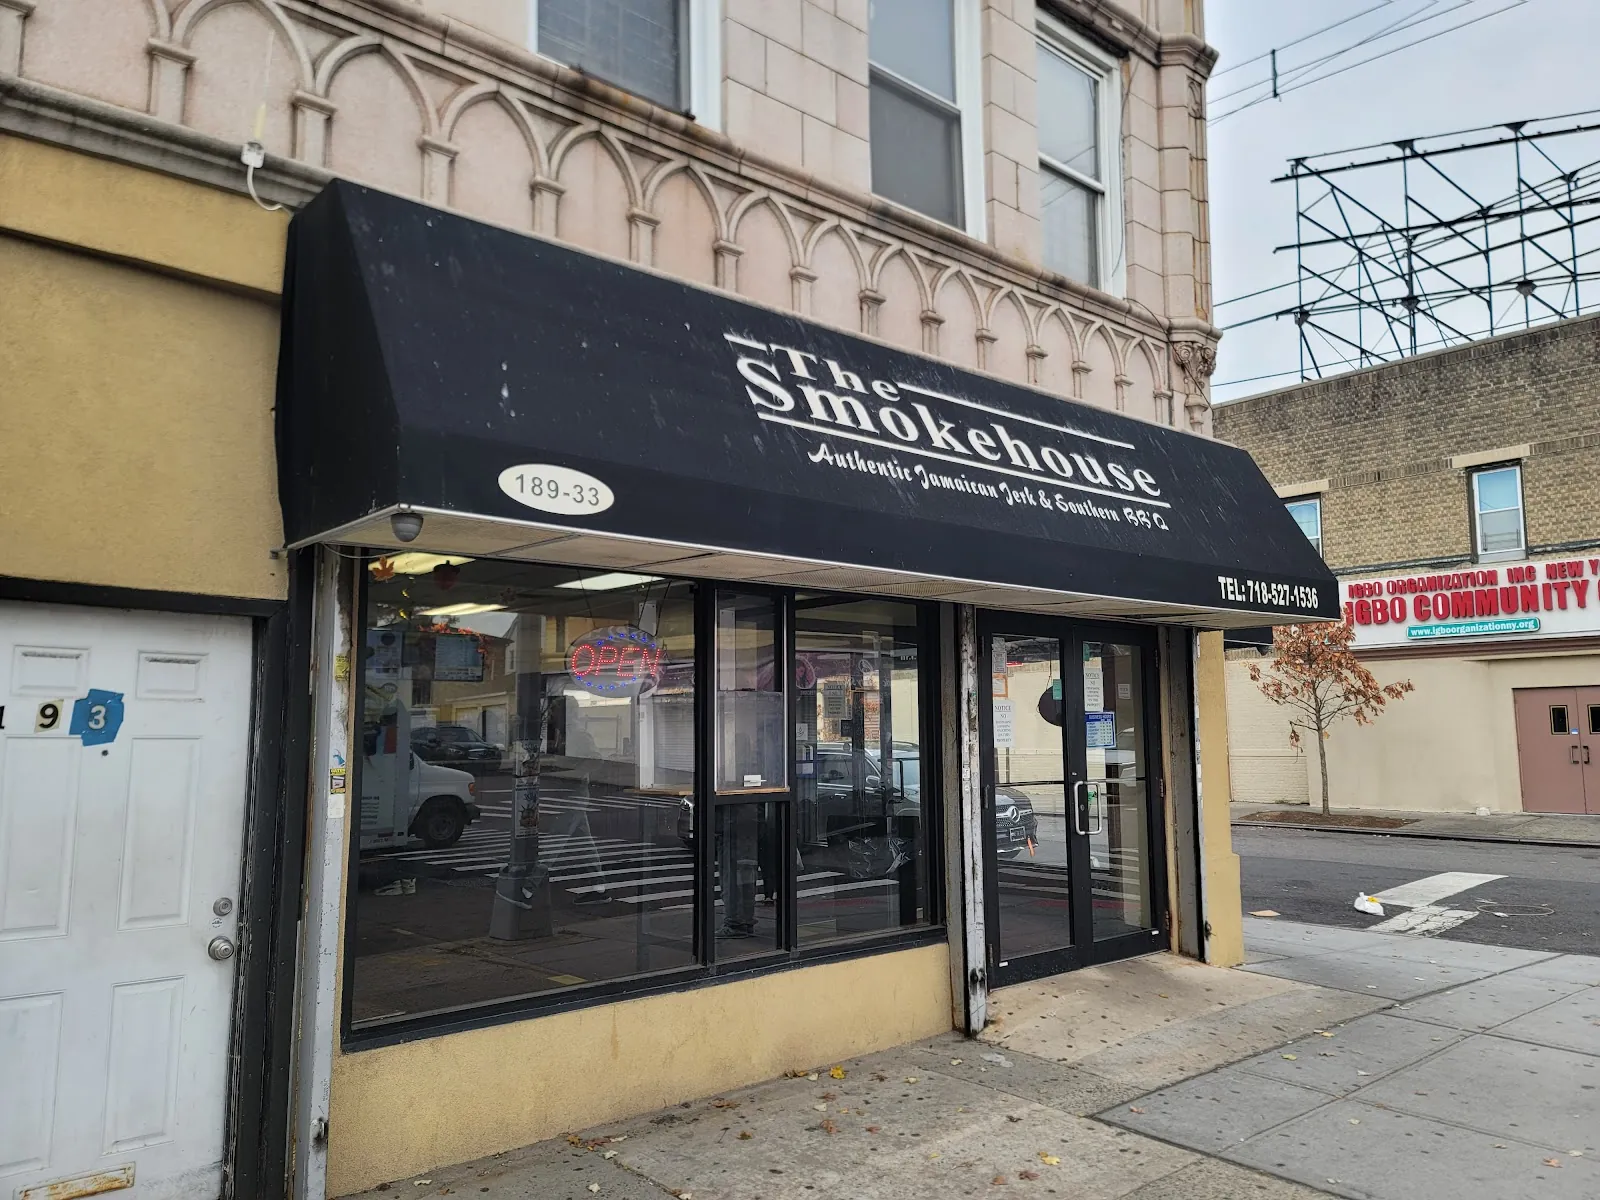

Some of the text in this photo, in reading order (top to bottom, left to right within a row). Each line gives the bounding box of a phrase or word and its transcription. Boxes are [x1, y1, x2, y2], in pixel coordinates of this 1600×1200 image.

[769, 343, 901, 402] The
[736, 357, 1161, 497] Smokehouse
[515, 473, 600, 506] 189-33
[807, 443, 1170, 531] Authentic Jamaican Jerk & Southern BB'Q
[1217, 576, 1319, 609] TEL: 718-527-1536
[1348, 581, 1383, 599] IGBO
[1386, 569, 1498, 596] ORGANIZATION
[1506, 565, 1537, 584] INC
[1545, 560, 1584, 580] NEW
[1344, 596, 1407, 626] IGBO
[1413, 579, 1590, 622] COMMUNITY
[1410, 619, 1535, 637] www.igboorganizationny.org
[571, 643, 662, 678] OPEN
[39, 703, 59, 729] 9
[88, 705, 107, 730] 3
